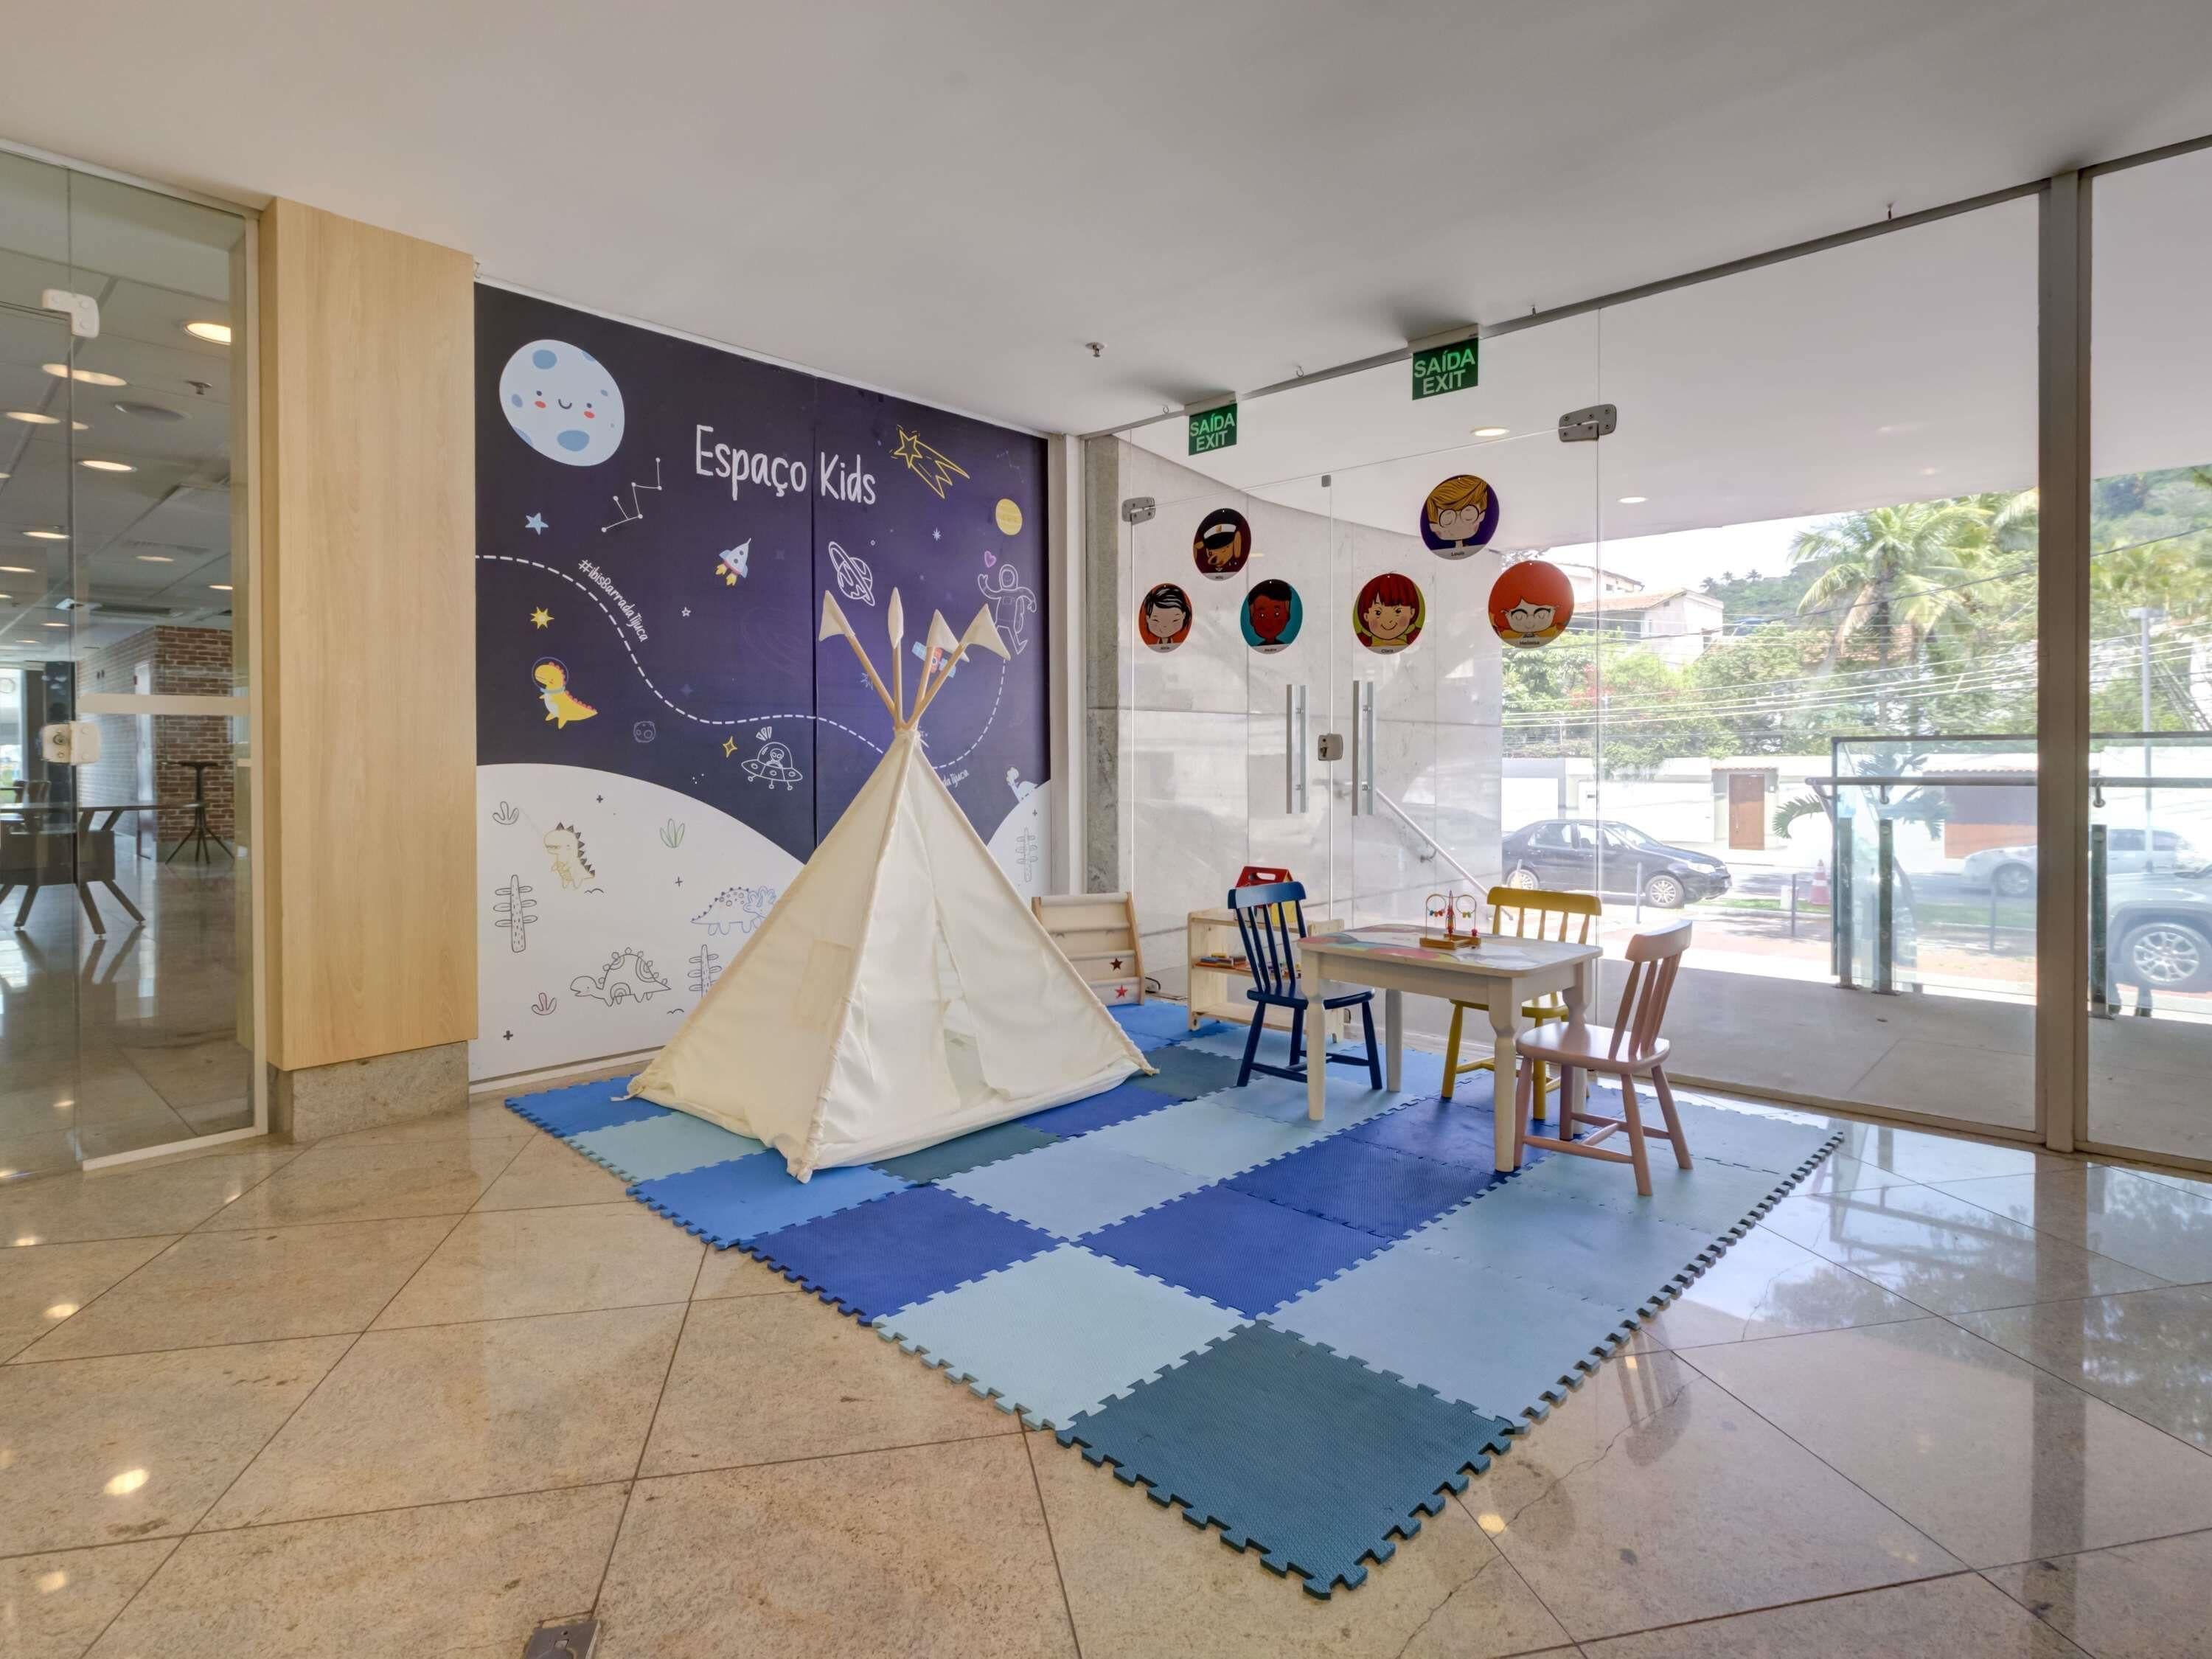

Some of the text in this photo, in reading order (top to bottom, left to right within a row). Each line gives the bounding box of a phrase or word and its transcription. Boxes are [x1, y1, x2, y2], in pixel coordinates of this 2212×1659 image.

[1414, 349, 1475, 378] SAÍDA
[1423, 369, 1466, 395] EXIT
[1190, 413, 1235, 437] SAÍDA
[1196, 430, 1228, 451] EXIT
[696, 424, 876, 504] Espaço Kids
